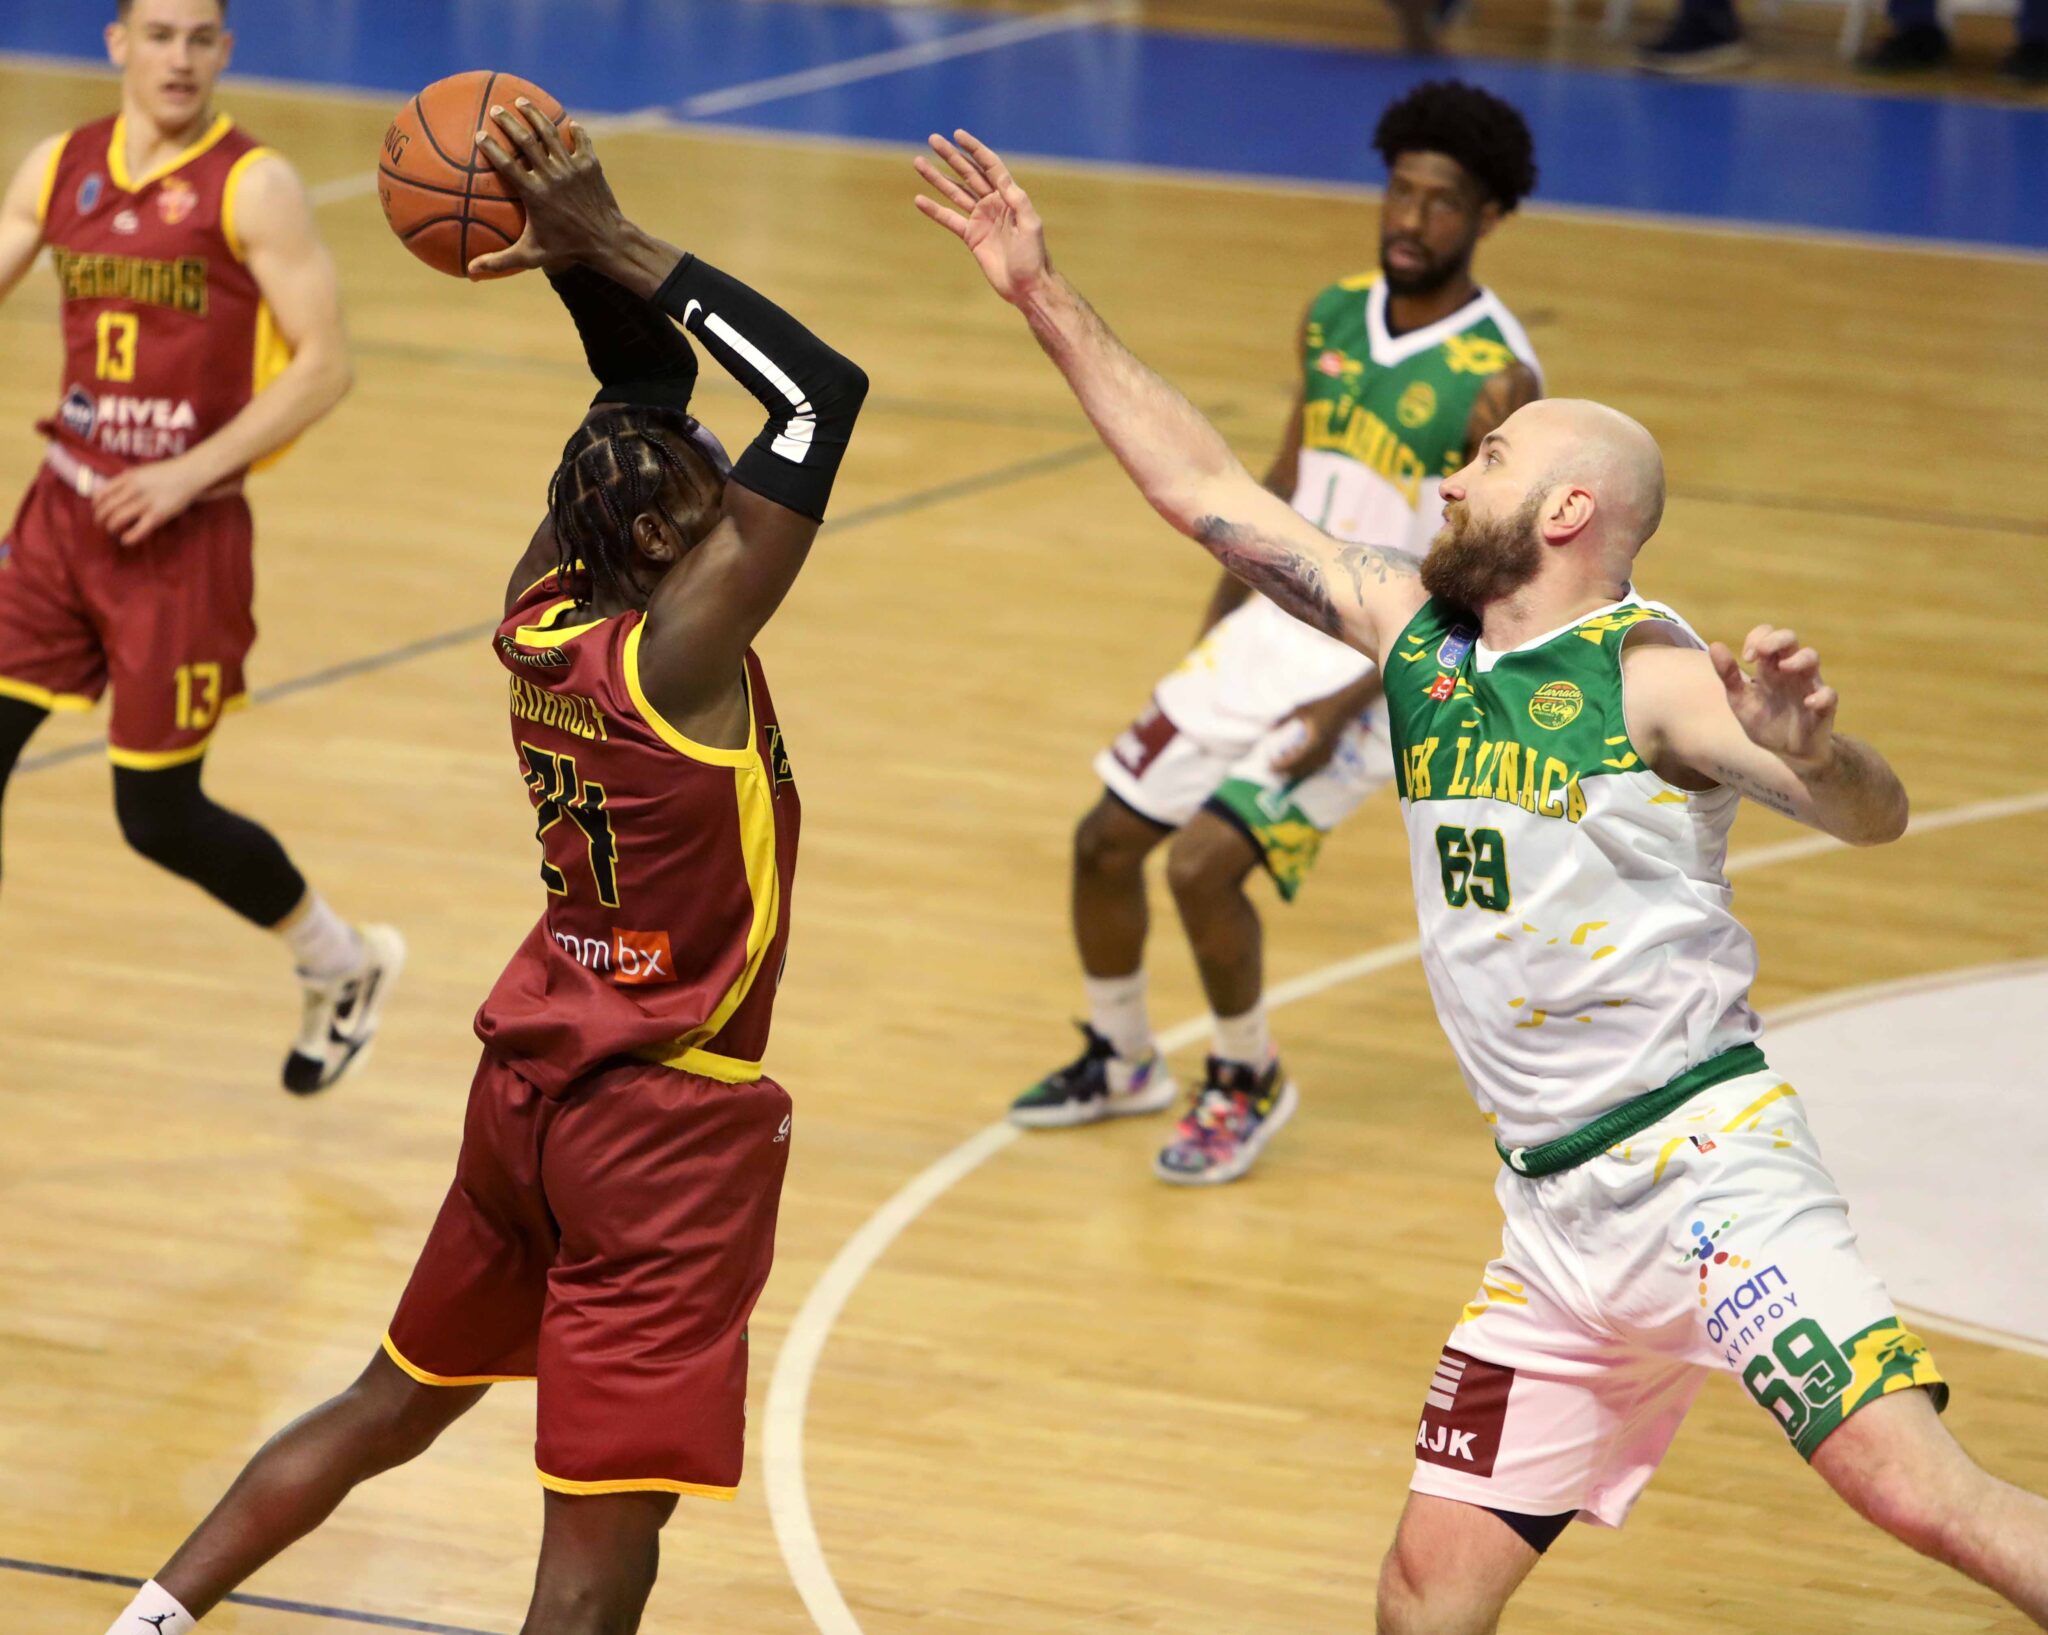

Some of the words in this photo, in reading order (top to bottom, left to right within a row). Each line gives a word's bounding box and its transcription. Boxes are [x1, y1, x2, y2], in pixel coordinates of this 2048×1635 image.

[96, 311, 138, 382] 13
[97, 396, 197, 430] NIVEA
[101, 427, 187, 457] MEN
[175, 662, 221, 730] 13
[1434, 824, 1511, 912] 69
[1742, 1317, 1854, 1439] 69
